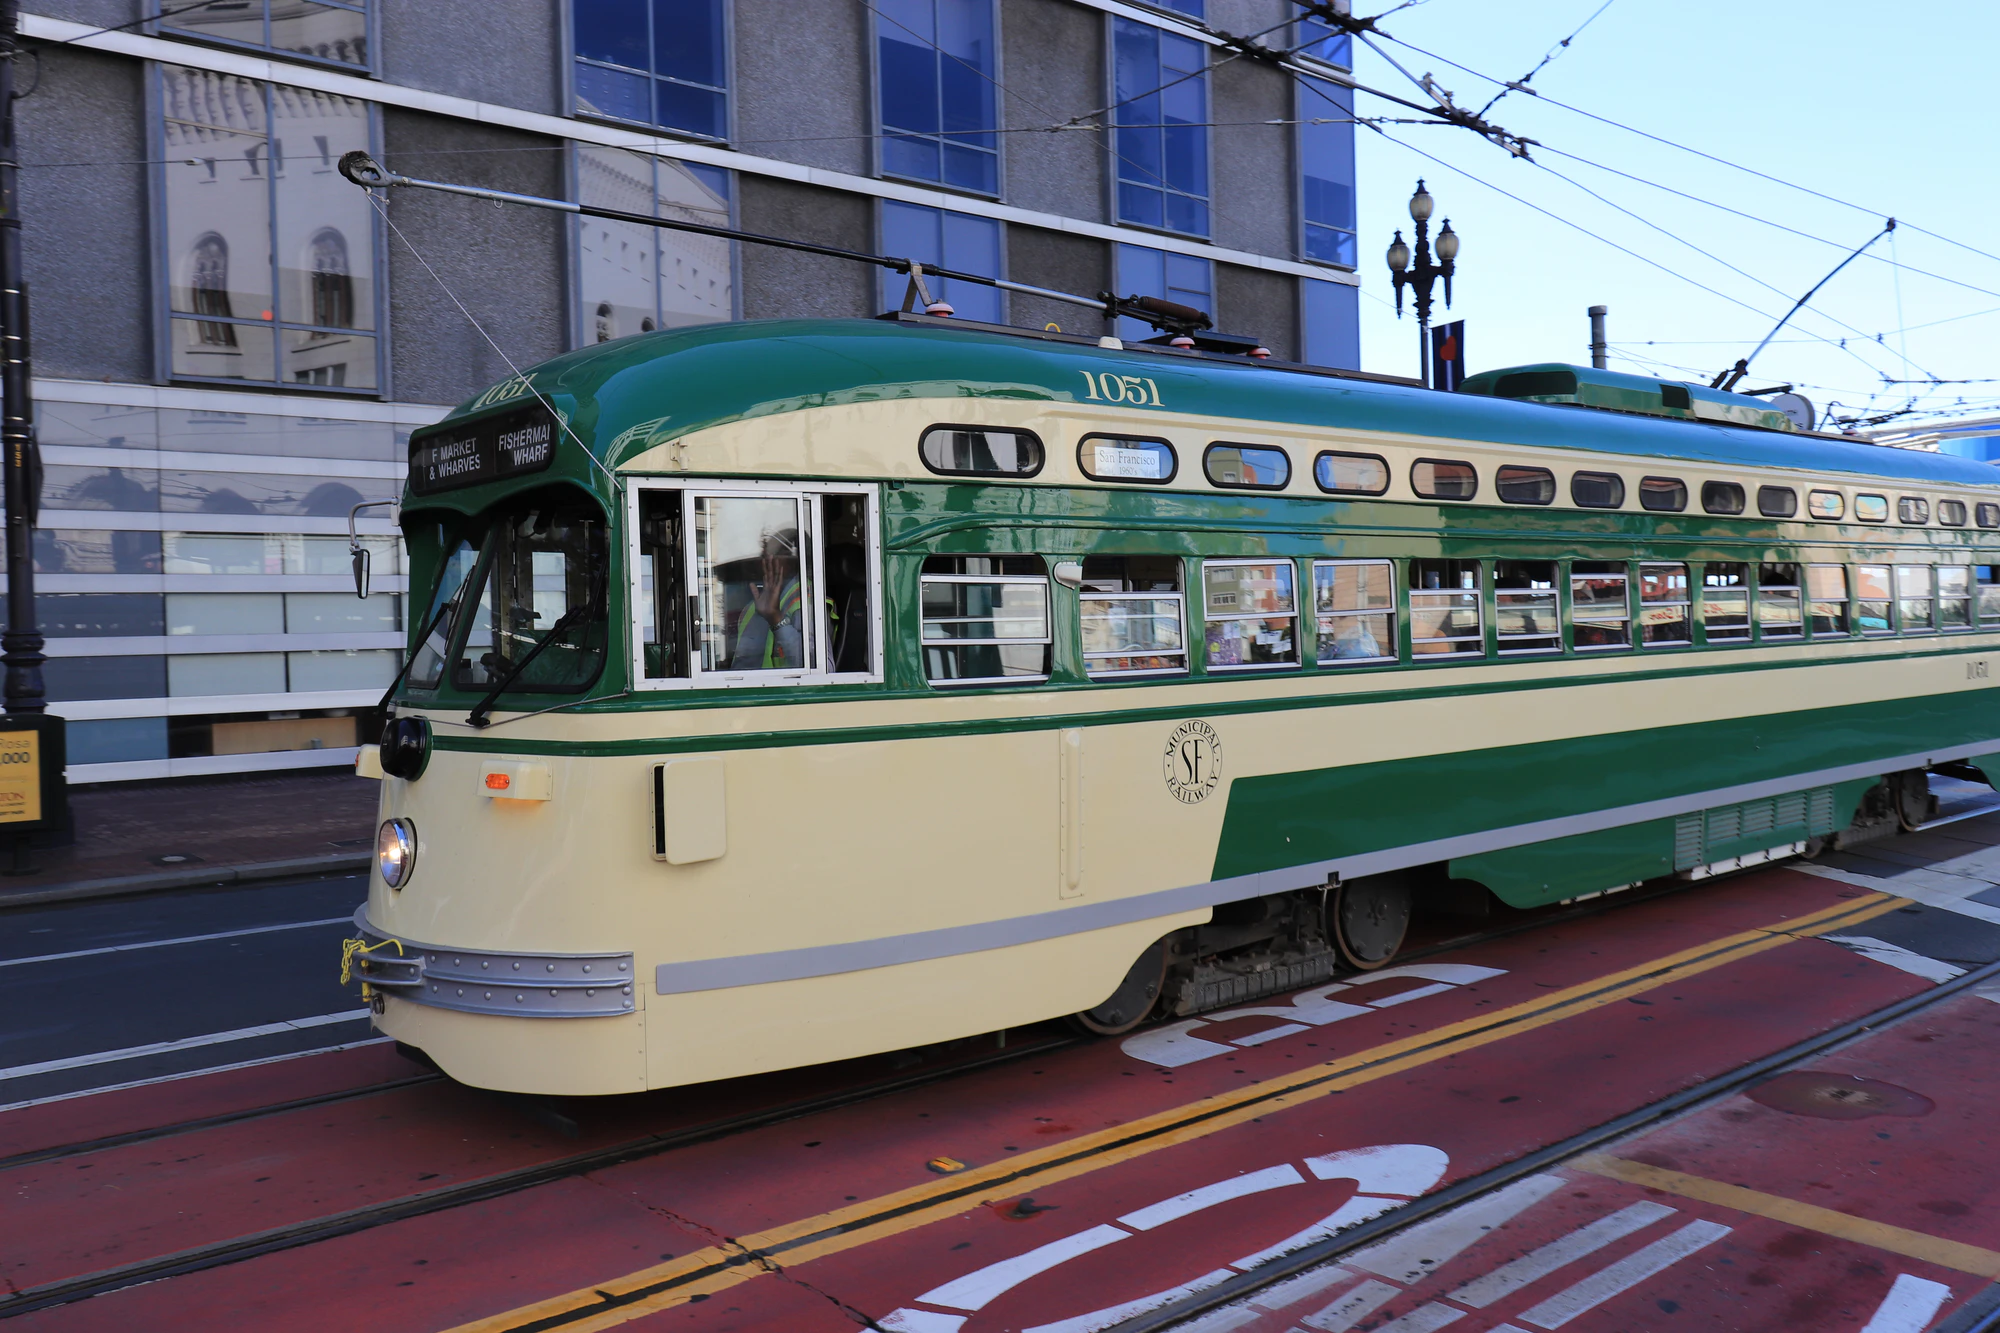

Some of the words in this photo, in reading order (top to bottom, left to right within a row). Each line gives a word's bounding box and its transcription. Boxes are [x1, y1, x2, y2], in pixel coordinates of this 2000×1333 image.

[470, 372, 538, 412] 1051
[1079, 370, 1166, 407] 1051
[432, 448, 438, 463] F
[440, 437, 477, 459] MARKET
[513, 443, 548, 466] WHARF
[1099, 450, 1115, 463] San
[1118, 451, 1156, 466] Francisco
[429, 466, 436, 481] &
[438, 453, 481, 478] WHARVES
[1166, 721, 1220, 757] MUNICIPAL
[1167, 771, 1218, 802] RAILWAY
